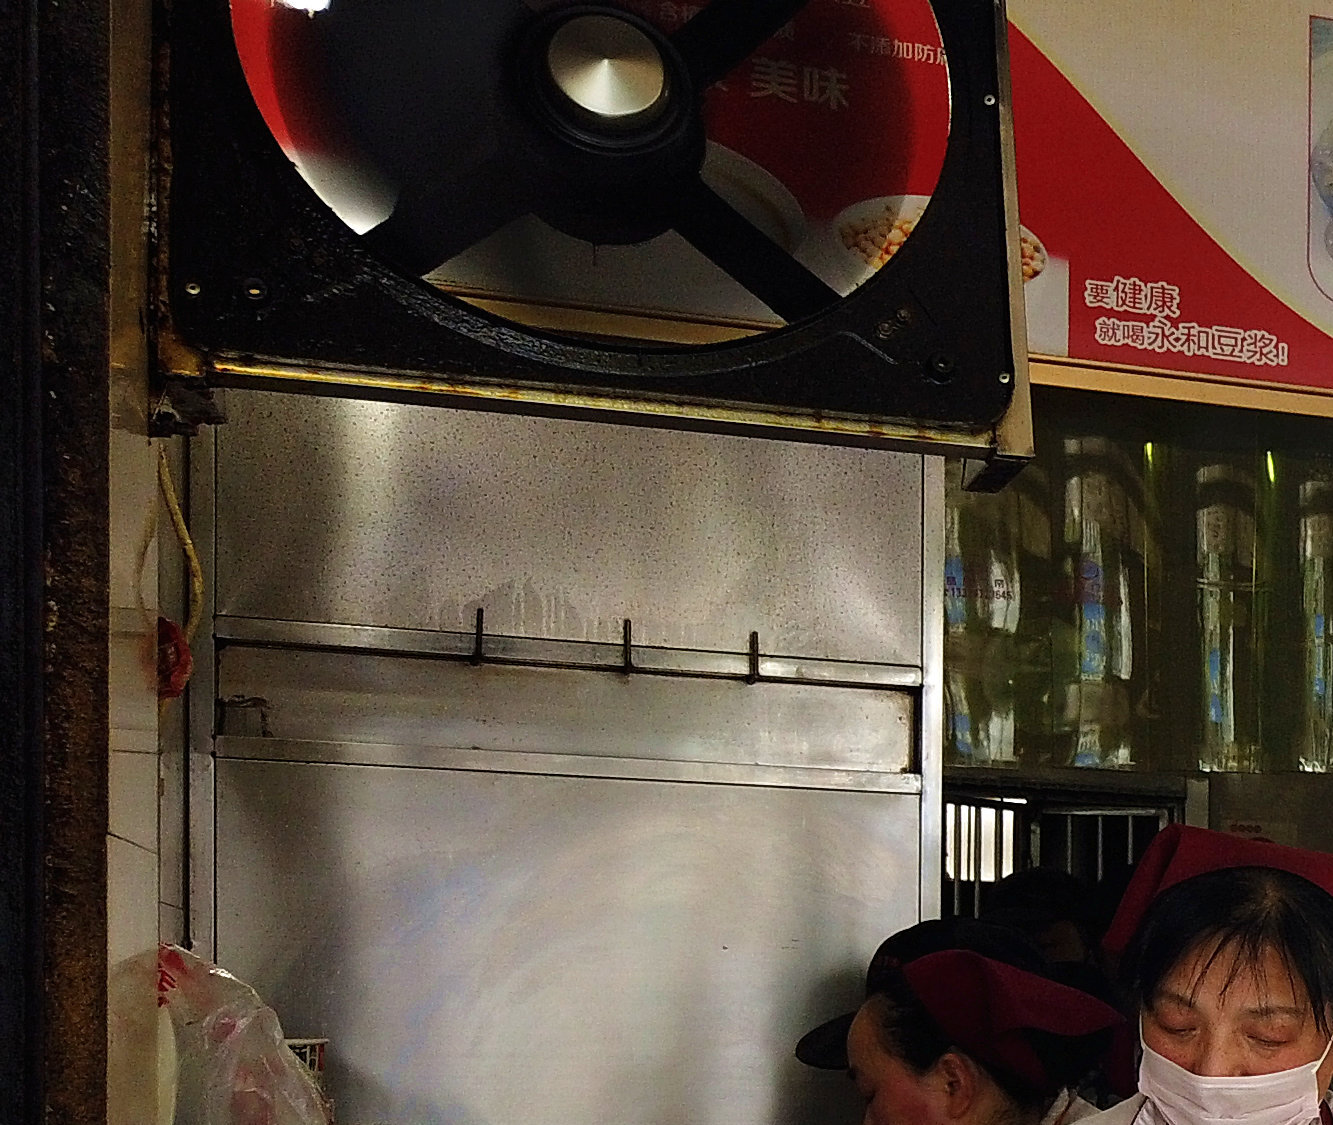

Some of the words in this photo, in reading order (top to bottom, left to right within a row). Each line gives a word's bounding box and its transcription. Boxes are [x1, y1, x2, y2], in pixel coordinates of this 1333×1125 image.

[704, 56, 850, 112] 美味
[1084, 274, 1181, 318] 要健康
